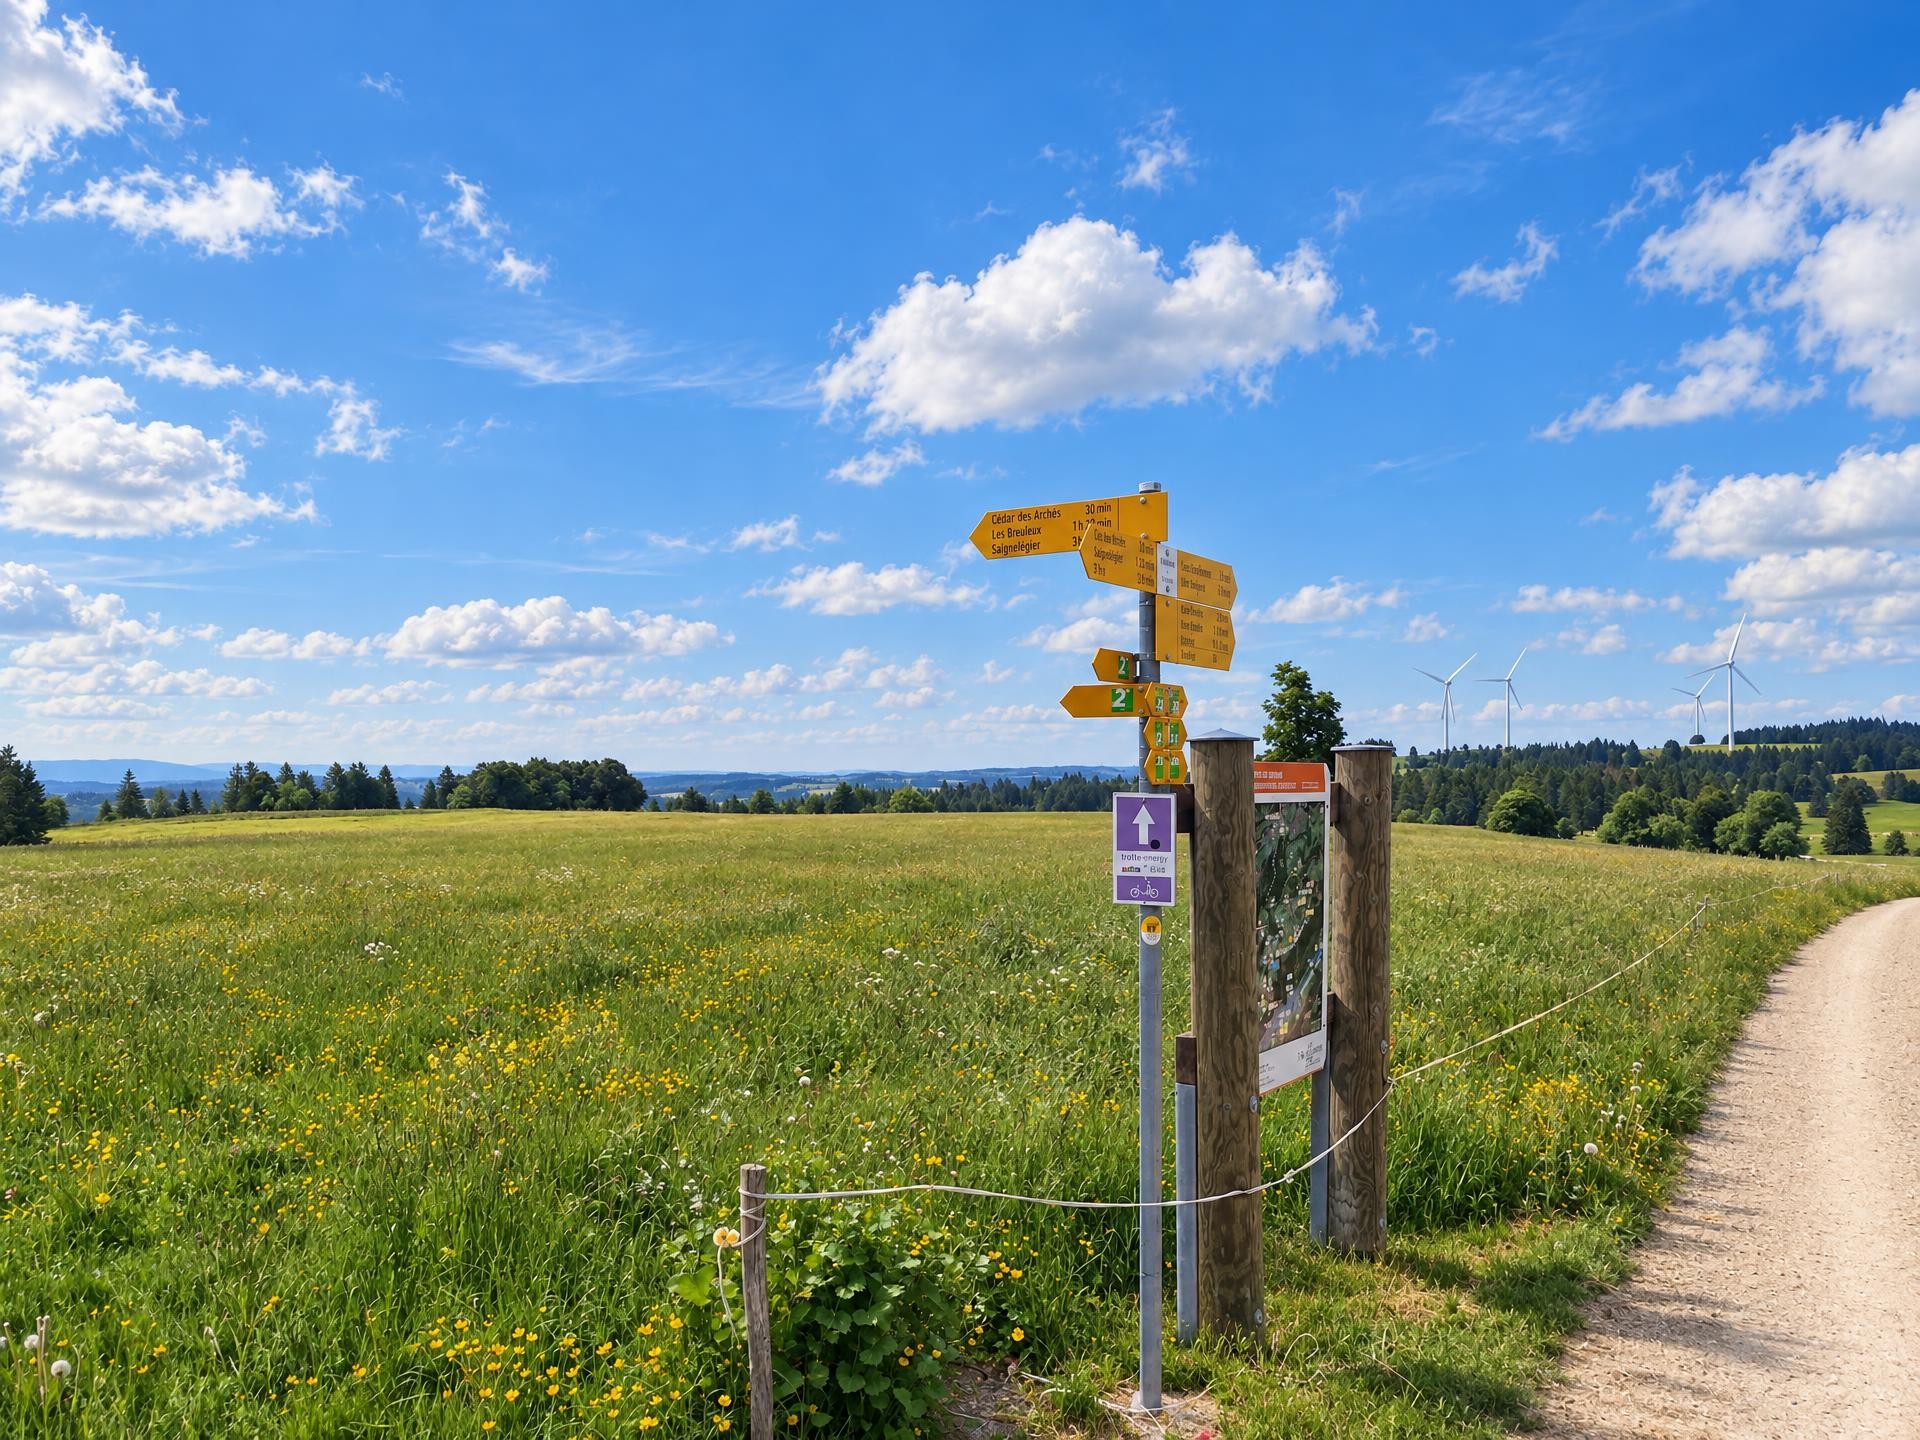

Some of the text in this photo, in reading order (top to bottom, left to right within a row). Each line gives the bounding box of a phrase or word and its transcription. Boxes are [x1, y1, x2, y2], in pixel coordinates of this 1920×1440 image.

[1017, 512, 1032, 522] des
[1085, 503, 1095, 515] 30
[1096, 502, 1112, 513] min
[992, 529, 1005, 540] Les
[1007, 526, 1042, 538] Breuleux
[991, 540, 1041, 556] Saignelégier
[1118, 656, 1126, 675] 2
[1112, 688, 1126, 708] 2
